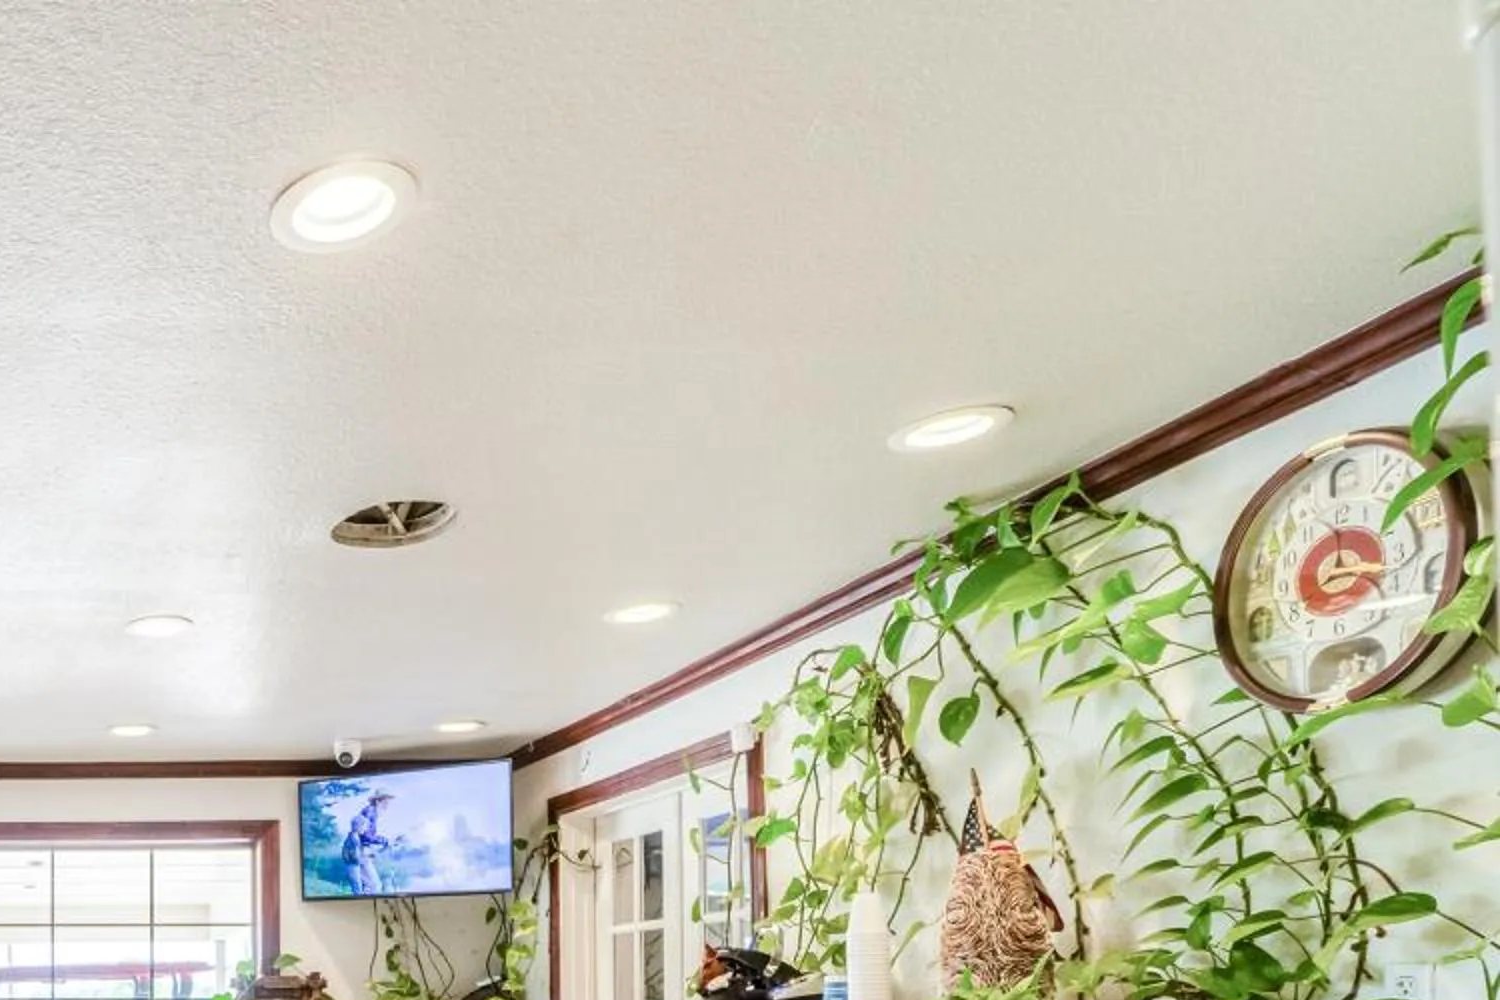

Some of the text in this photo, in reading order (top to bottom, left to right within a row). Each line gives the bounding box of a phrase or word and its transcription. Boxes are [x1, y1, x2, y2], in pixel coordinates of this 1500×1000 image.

[1279, 579, 1289, 593] 9
[1288, 603, 1302, 621] 8
[1304, 618, 1316, 638] 7
[1332, 618, 1346, 636] 6
